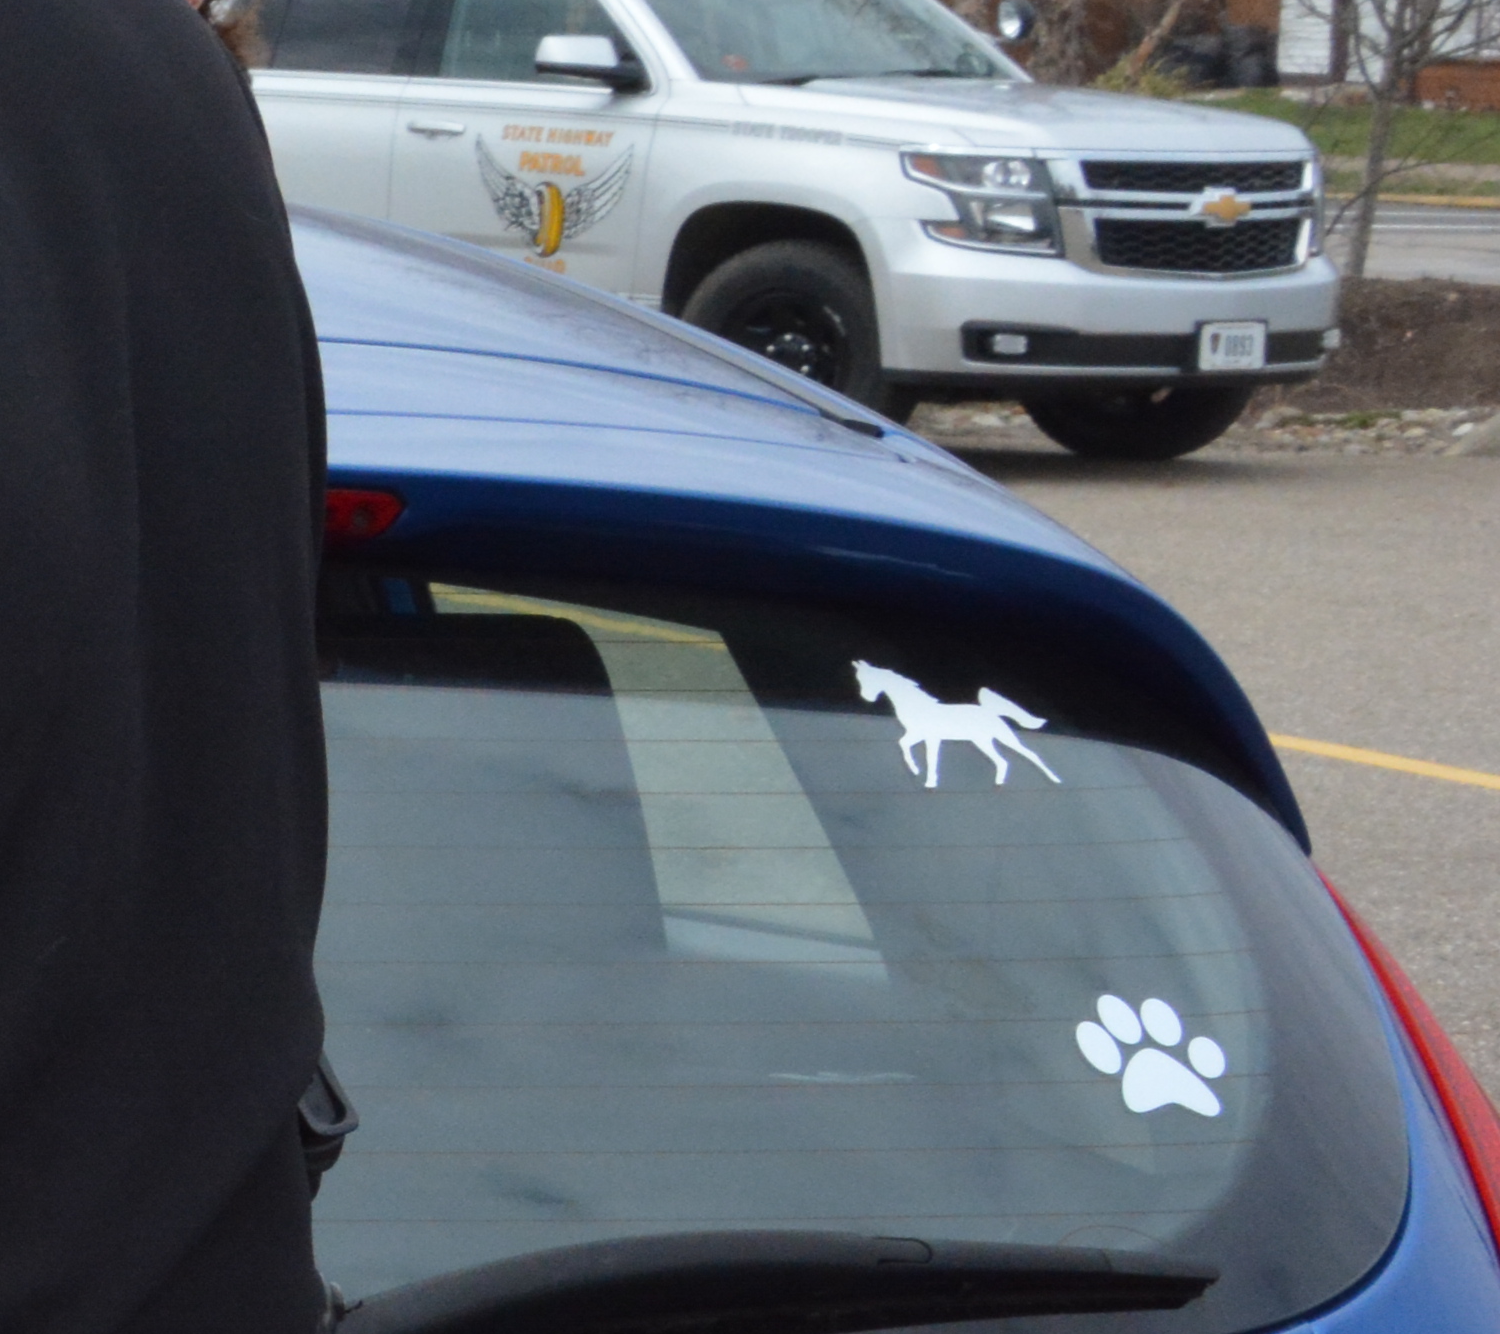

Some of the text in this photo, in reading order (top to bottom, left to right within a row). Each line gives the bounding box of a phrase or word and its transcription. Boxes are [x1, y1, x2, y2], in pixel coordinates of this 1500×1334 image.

[502, 124, 615, 147] STATE HIGHWAY
[518, 151, 585, 176] PATROL
